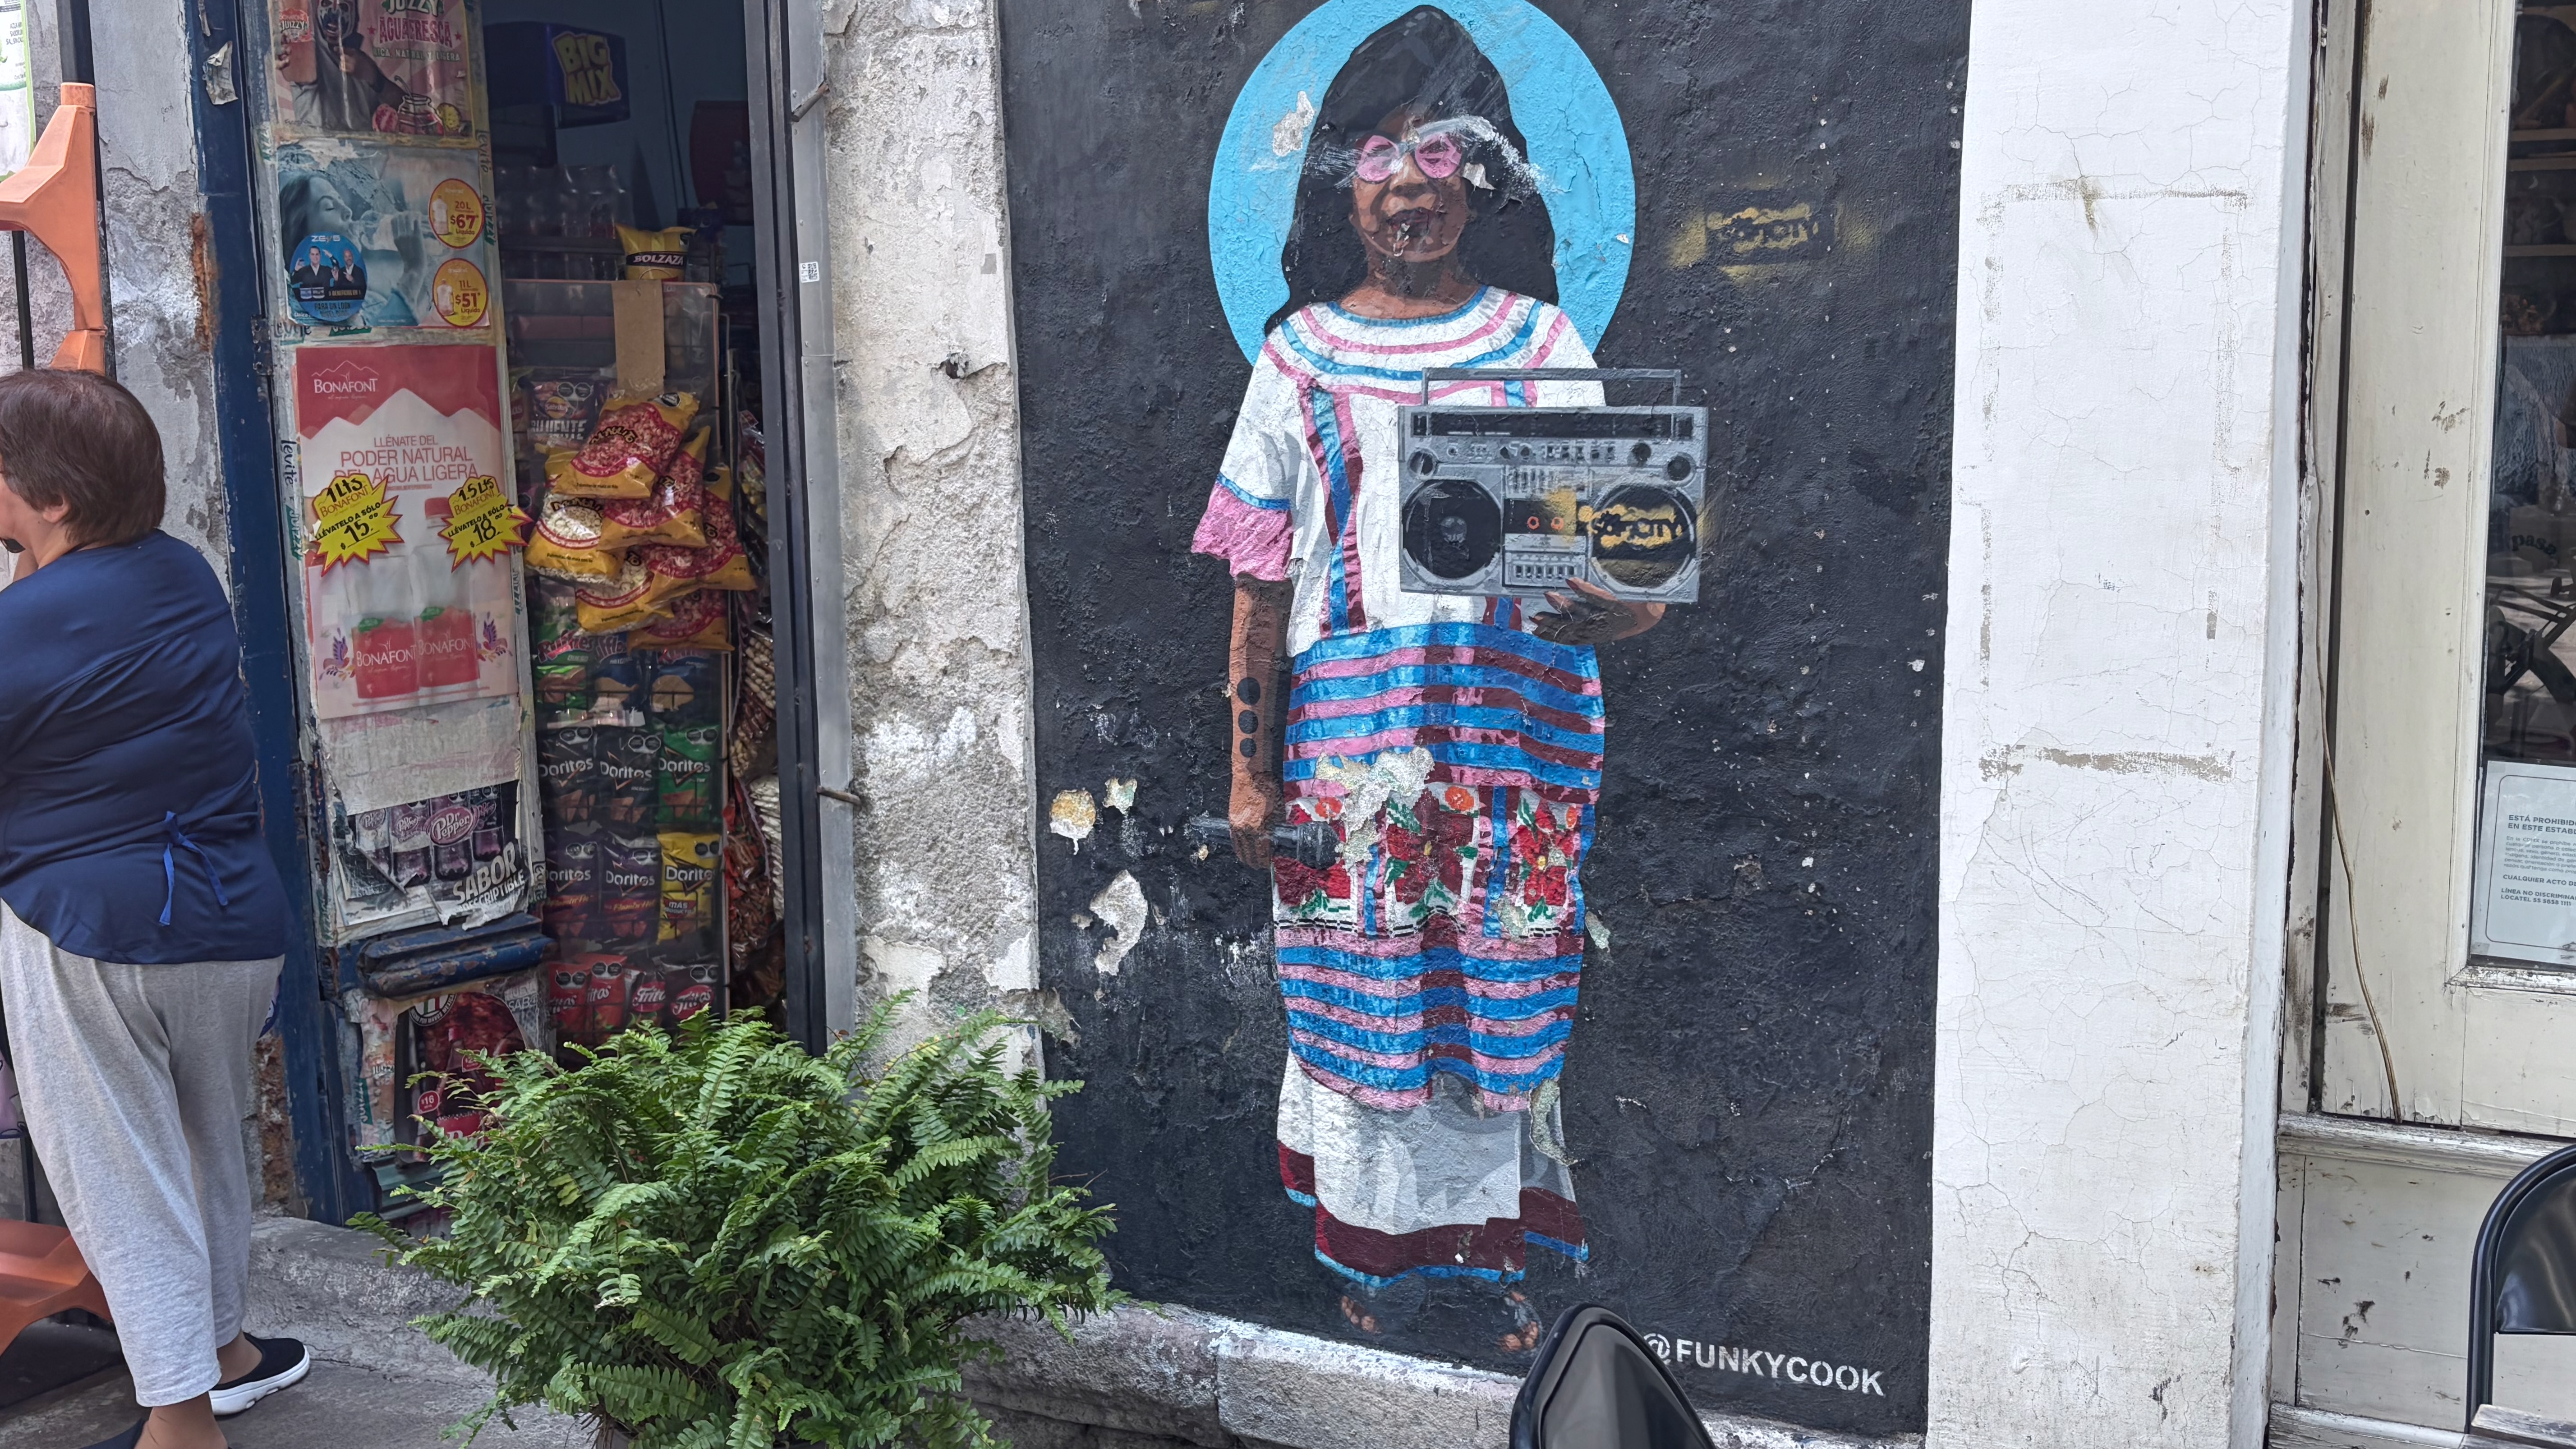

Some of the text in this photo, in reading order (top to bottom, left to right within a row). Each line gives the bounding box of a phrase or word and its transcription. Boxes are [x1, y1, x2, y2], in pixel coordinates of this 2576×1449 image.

[555, 35, 607, 73] BIG
[568, 64, 620, 104] MIX
[633, 254, 684, 266] BOLZAZA
[313, 378, 378, 393] BONAFONT
[373, 434, 439, 448] LLÉNATE DEL
[340, 446, 473, 467] PODER NATURAL
[372, 463, 479, 484] AGUA LIGERA
[320, 485, 369, 517] BONAFONT
[454, 489, 495, 515] BONAFONT
[315, 516, 354, 541] LLÉVATELO
[361, 502, 381, 516] SÓLO
[448, 515, 482, 538] LLÉVATELO
[488, 504, 505, 516] SÓLO
[418, 633, 475, 655] BONAFONT
[357, 644, 417, 667] BONAFONT
[541, 757, 593, 777] Doritos
[600, 761, 652, 779] Doritos
[658, 757, 711, 773] Doritos
[434, 811, 470, 840] Dr Pepper
[453, 841, 517, 904] SABOR
[606, 870, 655, 886] Doritos
[2503, 874, 2544, 883] CUALQUIER
[1643, 1333, 1885, 1397] @FUNKYCOOK
